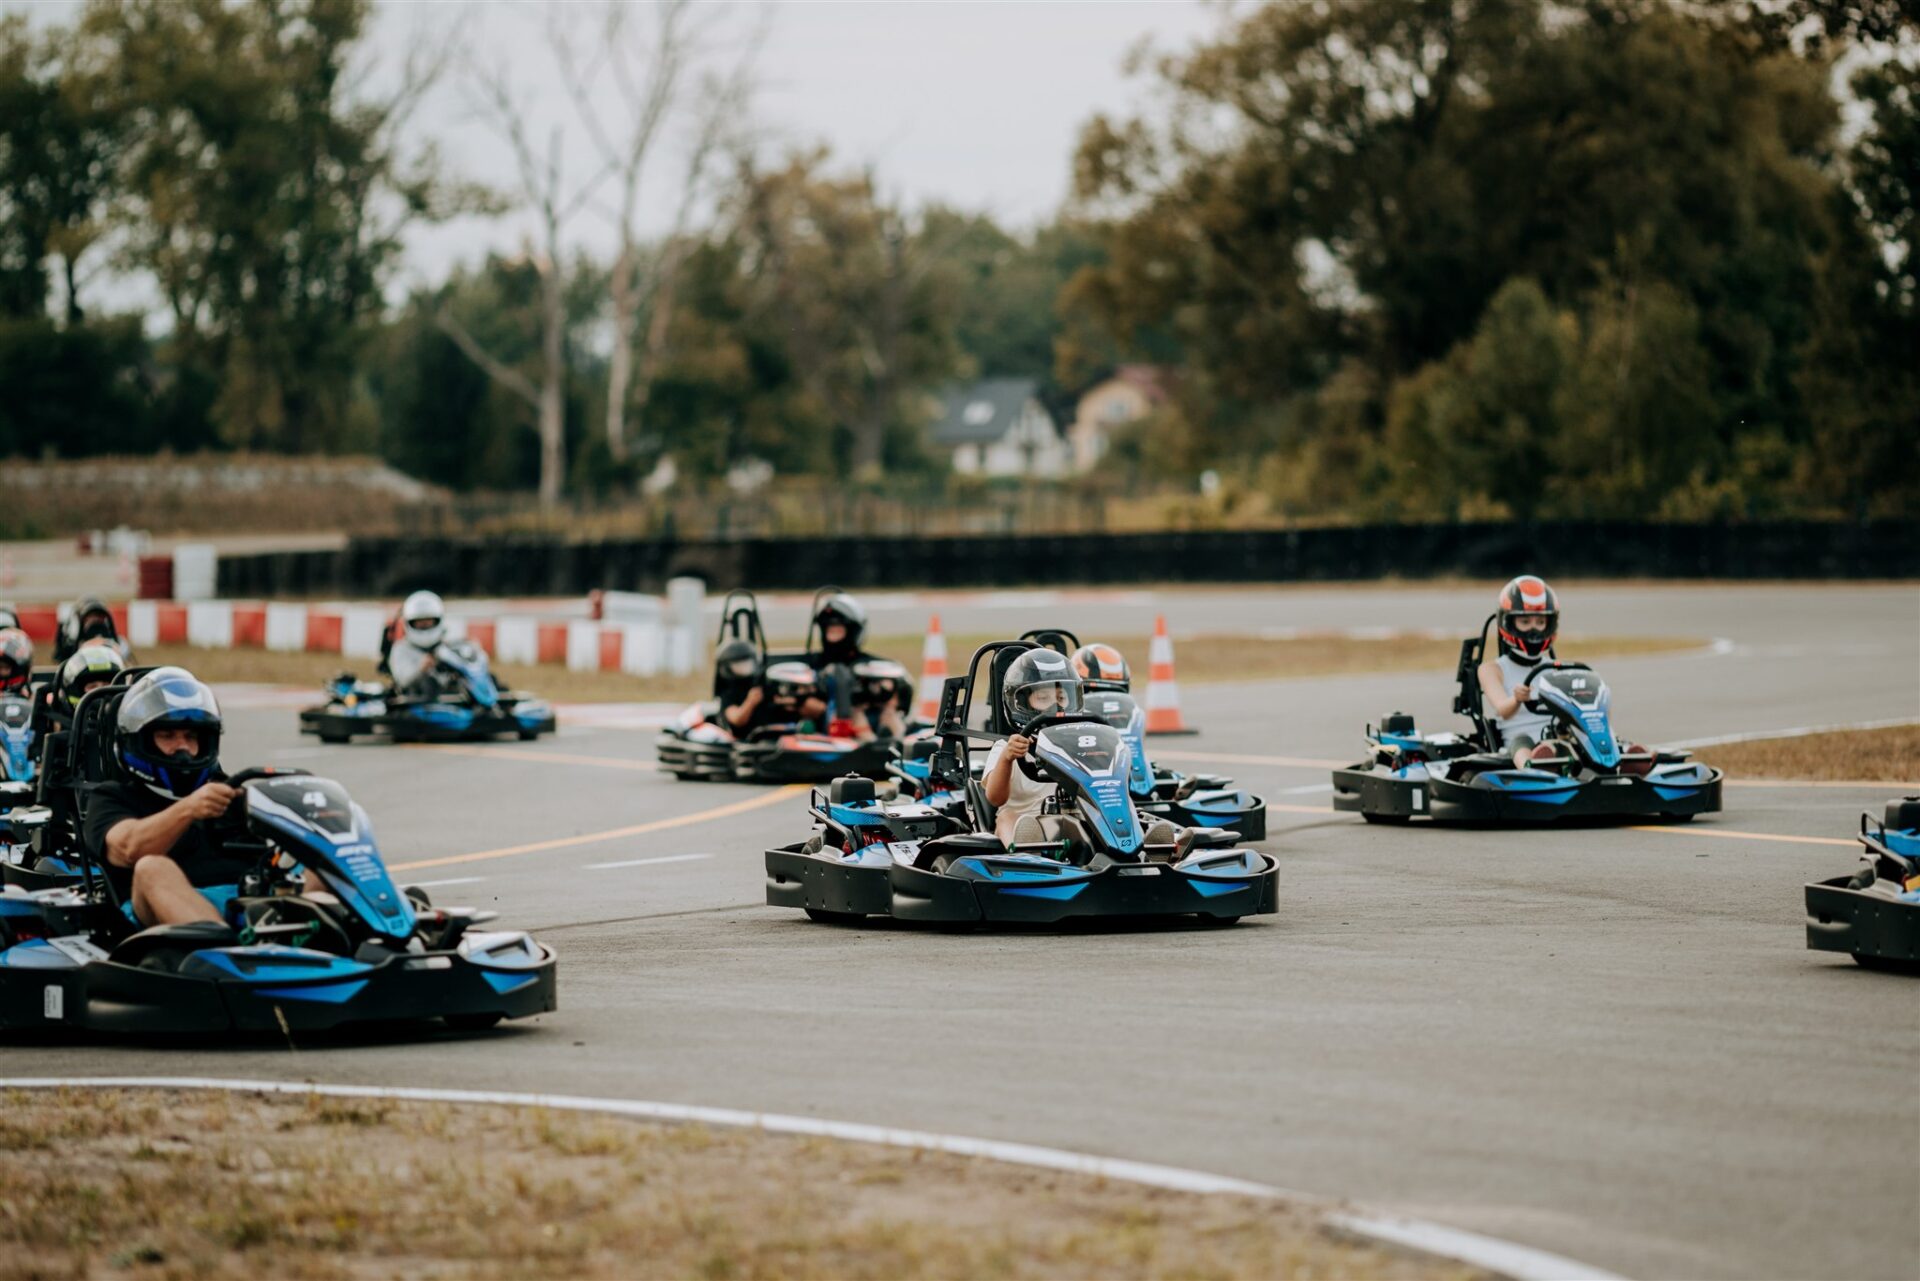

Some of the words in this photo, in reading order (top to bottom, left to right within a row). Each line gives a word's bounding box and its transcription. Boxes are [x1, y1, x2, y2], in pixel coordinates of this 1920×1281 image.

[1103, 702, 1119, 712] 5
[1078, 735, 1097, 748] 8
[302, 791, 327, 808] 4
